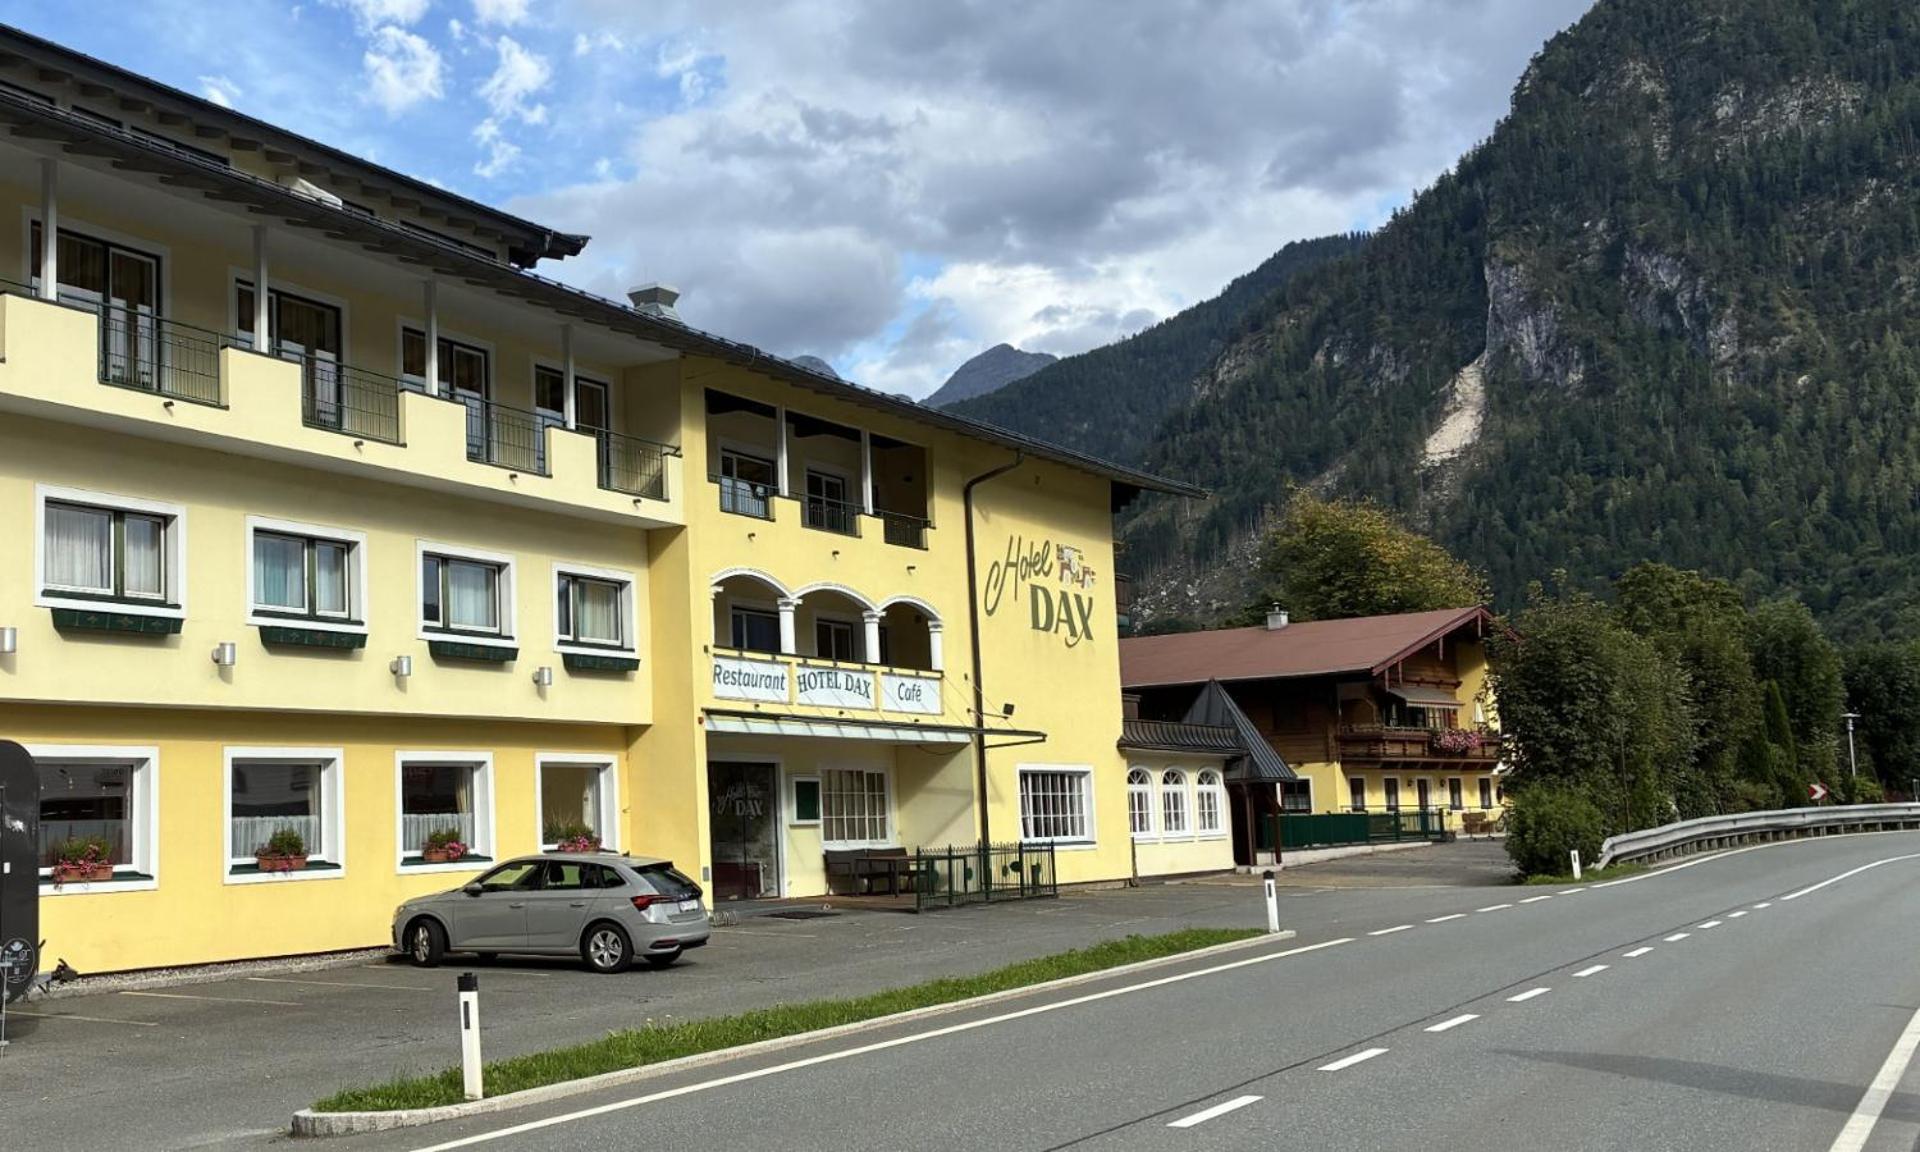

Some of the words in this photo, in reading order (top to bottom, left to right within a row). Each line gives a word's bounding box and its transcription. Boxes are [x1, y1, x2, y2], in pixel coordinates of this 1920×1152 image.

[984, 534, 1053, 616] Hotel
[1029, 583, 1094, 648] DAX
[713, 663, 785, 691] Restaurant
[797, 671, 842, 694] HOTEL
[844, 673, 873, 699] DAX
[897, 682, 922, 702] Café
